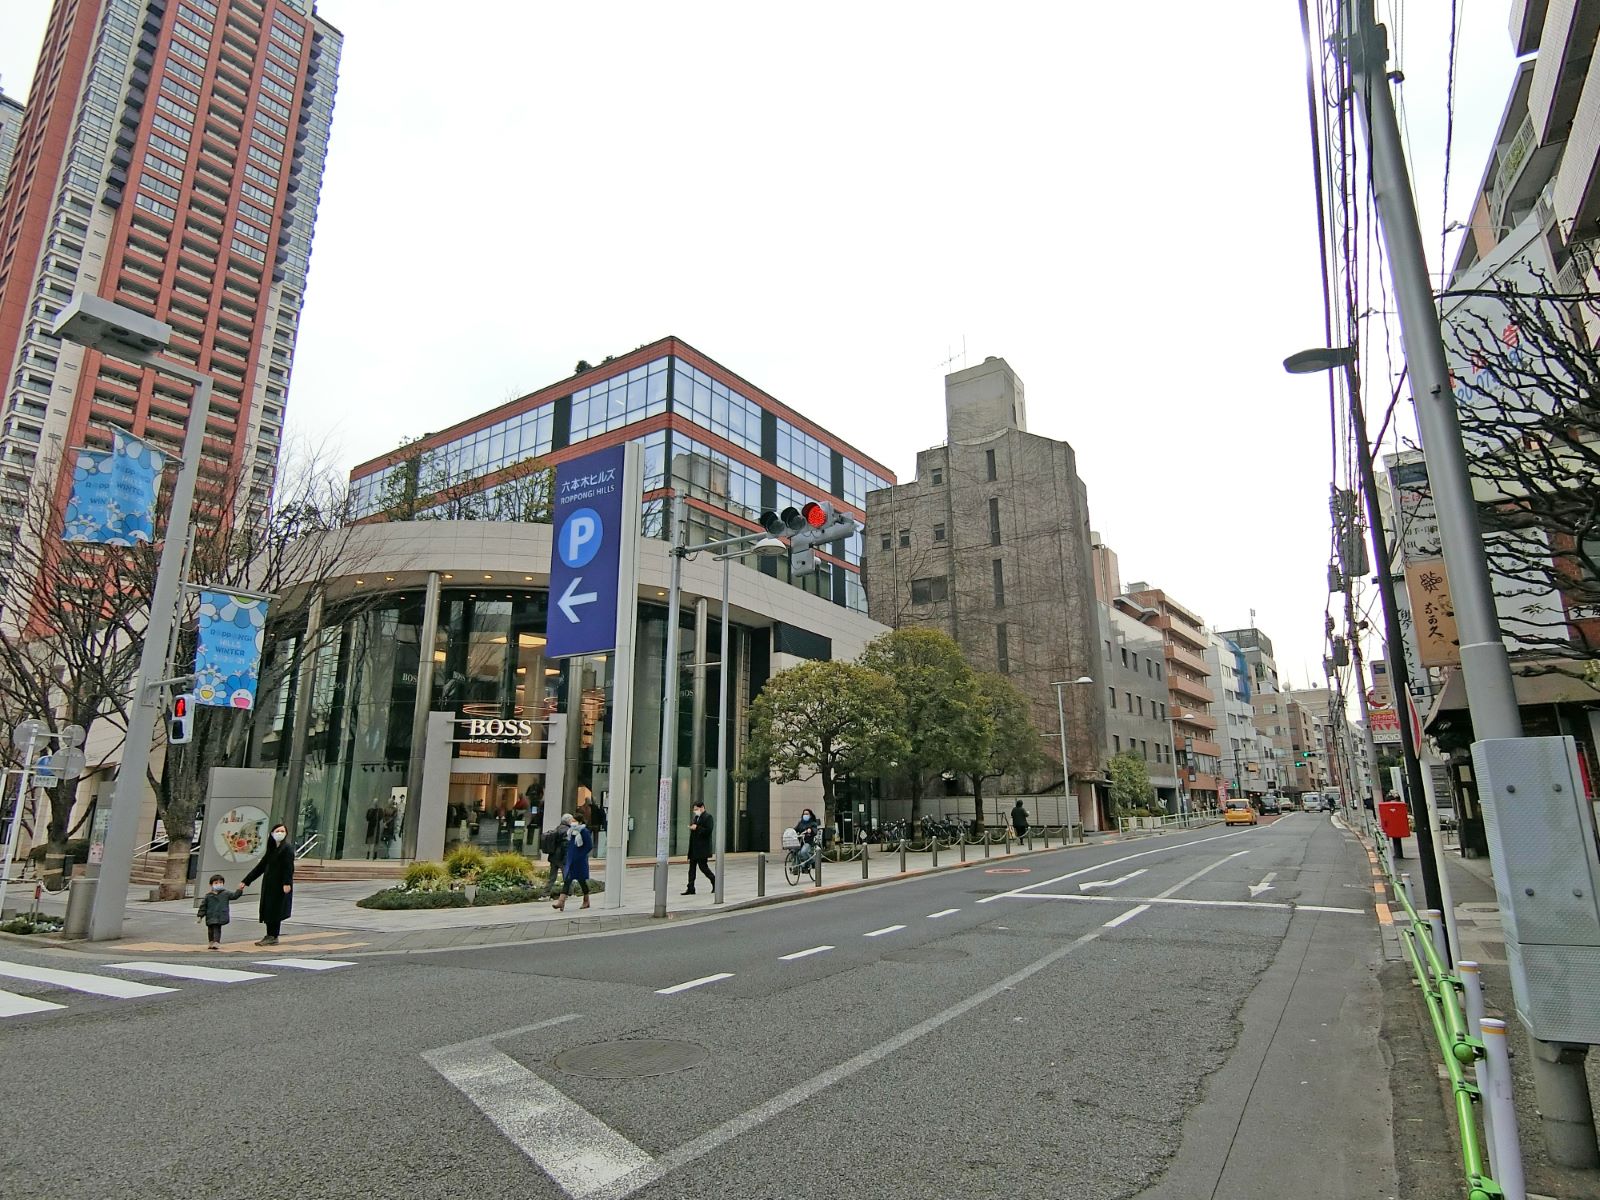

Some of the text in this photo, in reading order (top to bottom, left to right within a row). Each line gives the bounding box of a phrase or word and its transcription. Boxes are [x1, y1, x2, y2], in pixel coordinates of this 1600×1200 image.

[561, 468, 616, 493] 六本木ヒルズ
[560, 484, 615, 505] ROPPONGI HILLS
[568, 516, 595, 561] P
[215, 646, 245, 656] WINTER
[468, 718, 532, 737] BOSS
